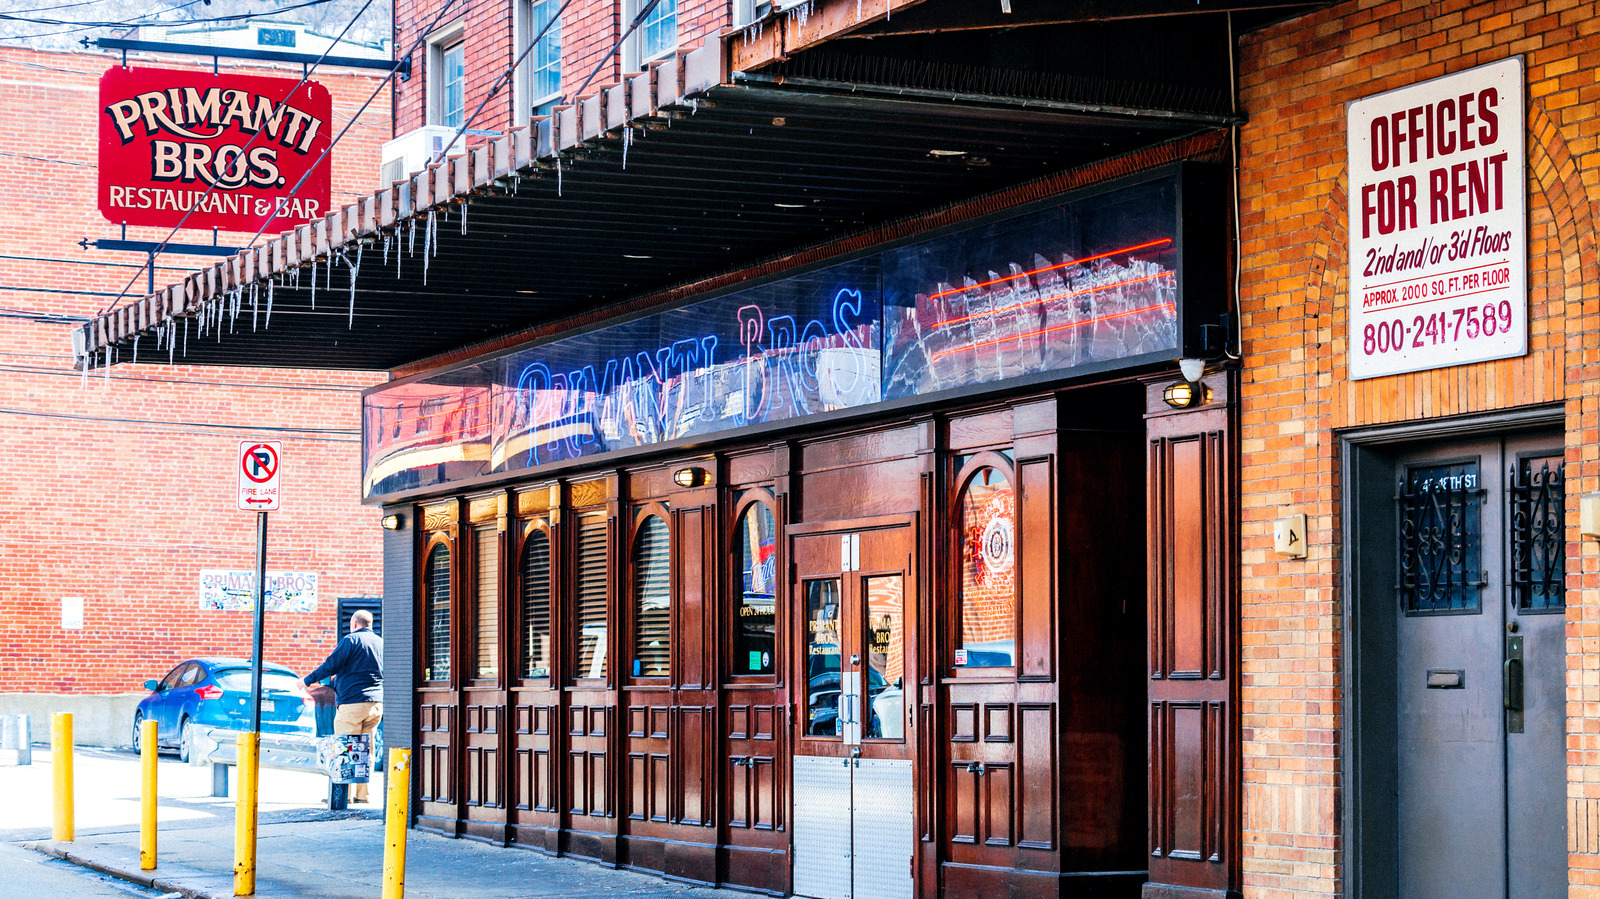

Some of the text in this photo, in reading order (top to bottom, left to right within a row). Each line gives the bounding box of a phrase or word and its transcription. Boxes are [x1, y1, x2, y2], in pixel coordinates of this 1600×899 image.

[104, 87, 322, 155] PRIMANTI
[1370, 87, 1499, 172] OFFICES
[151, 140, 286, 190] BROS.
[108, 185, 320, 219] RESTAURANT & BAR
[1361, 152, 1508, 239] FOR RENT
[1470, 225, 1512, 257] Floors
[1362, 267, 1510, 308] APPROX. 2000 SQ. FT. PER FLOOR
[1363, 300, 1512, 356] 800-241-7589
[517, 288, 867, 468] PRIMANTI BROS
[241, 487, 277, 496] FIRE LANE
[1464, 473, 1477, 489] ST
[204, 574, 272, 590] PRIMAI
[740, 606, 753, 617] OPEN
[761, 605, 776, 615] HOUR
[809, 619, 838, 632] PRIMANT
[809, 644, 840, 656] Restauran
[876, 631, 891, 644] BRO
